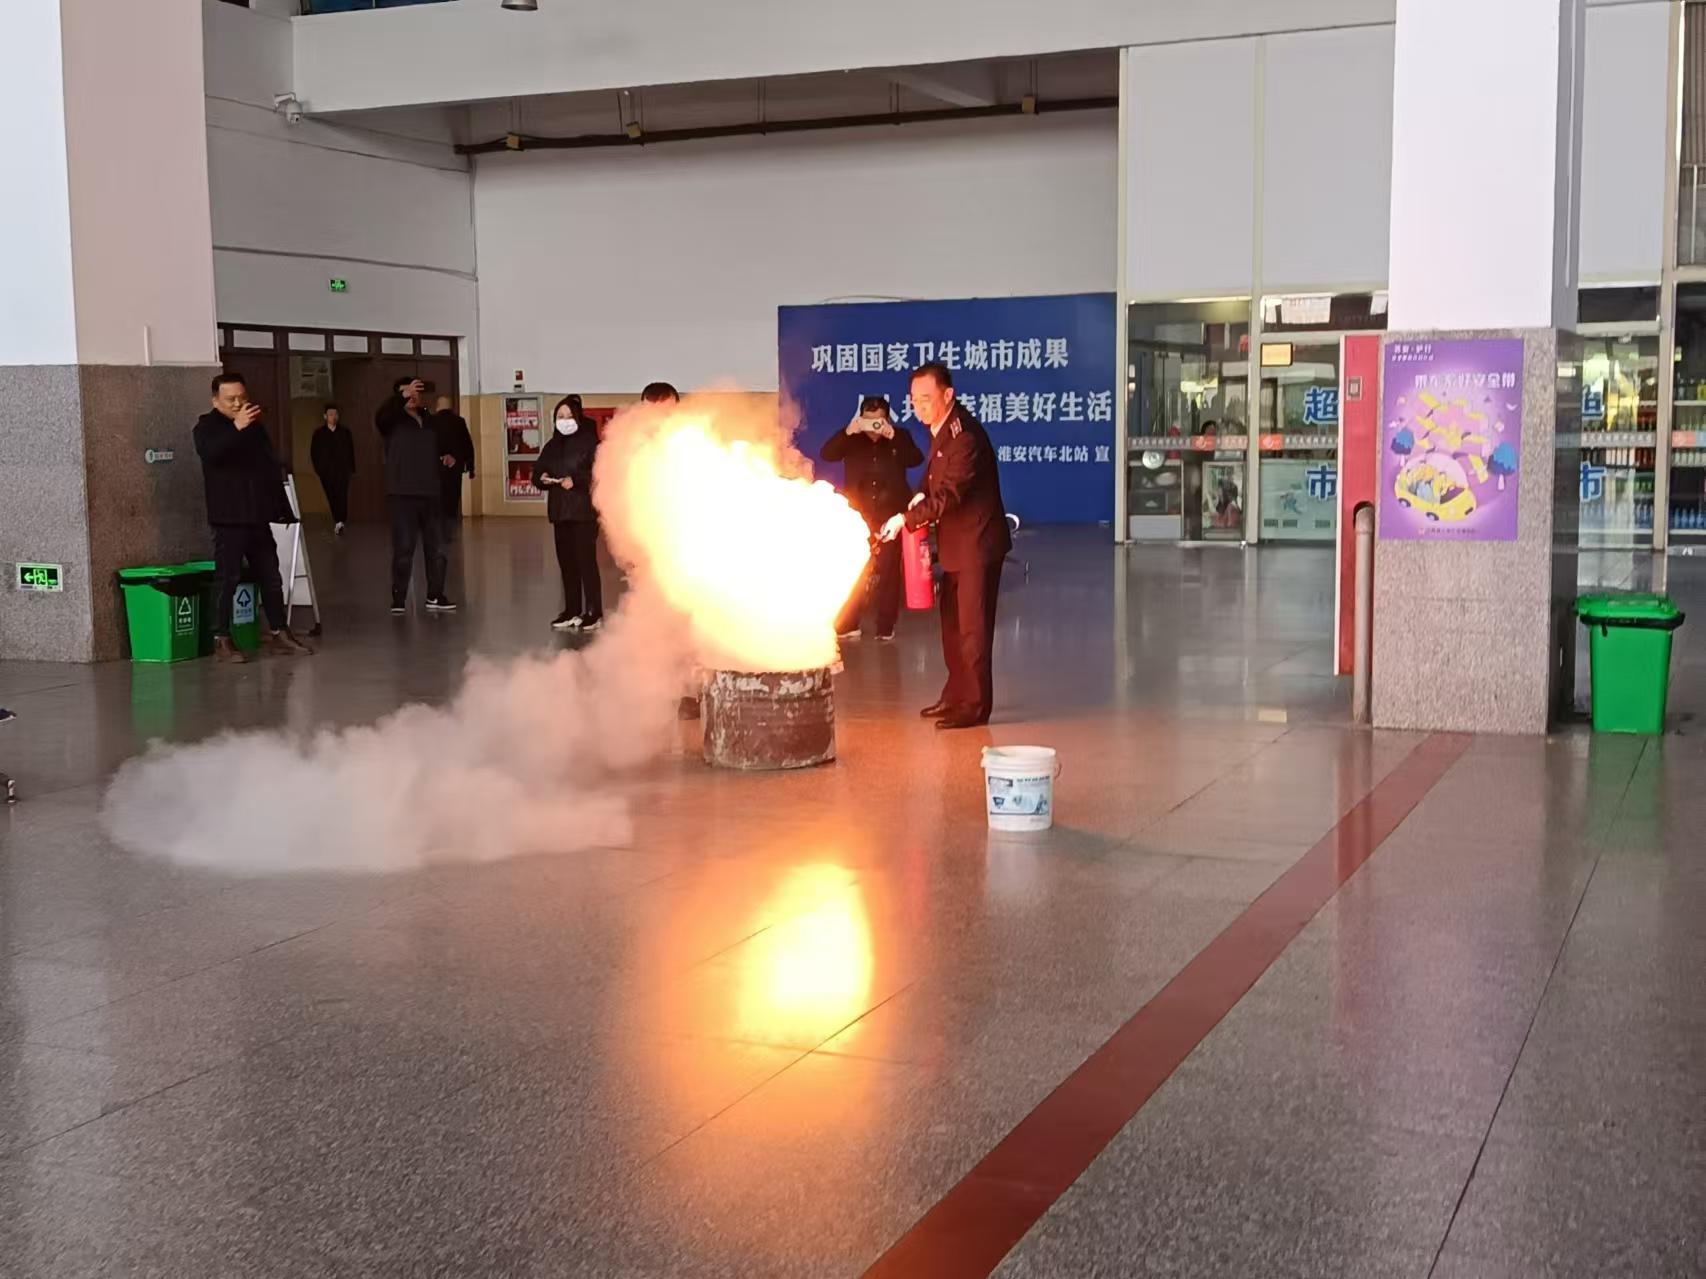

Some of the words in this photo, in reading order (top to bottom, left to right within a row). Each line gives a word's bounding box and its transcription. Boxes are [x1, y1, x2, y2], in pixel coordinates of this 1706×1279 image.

[811, 338, 1069, 373] 巩固国家卫生城市成果
